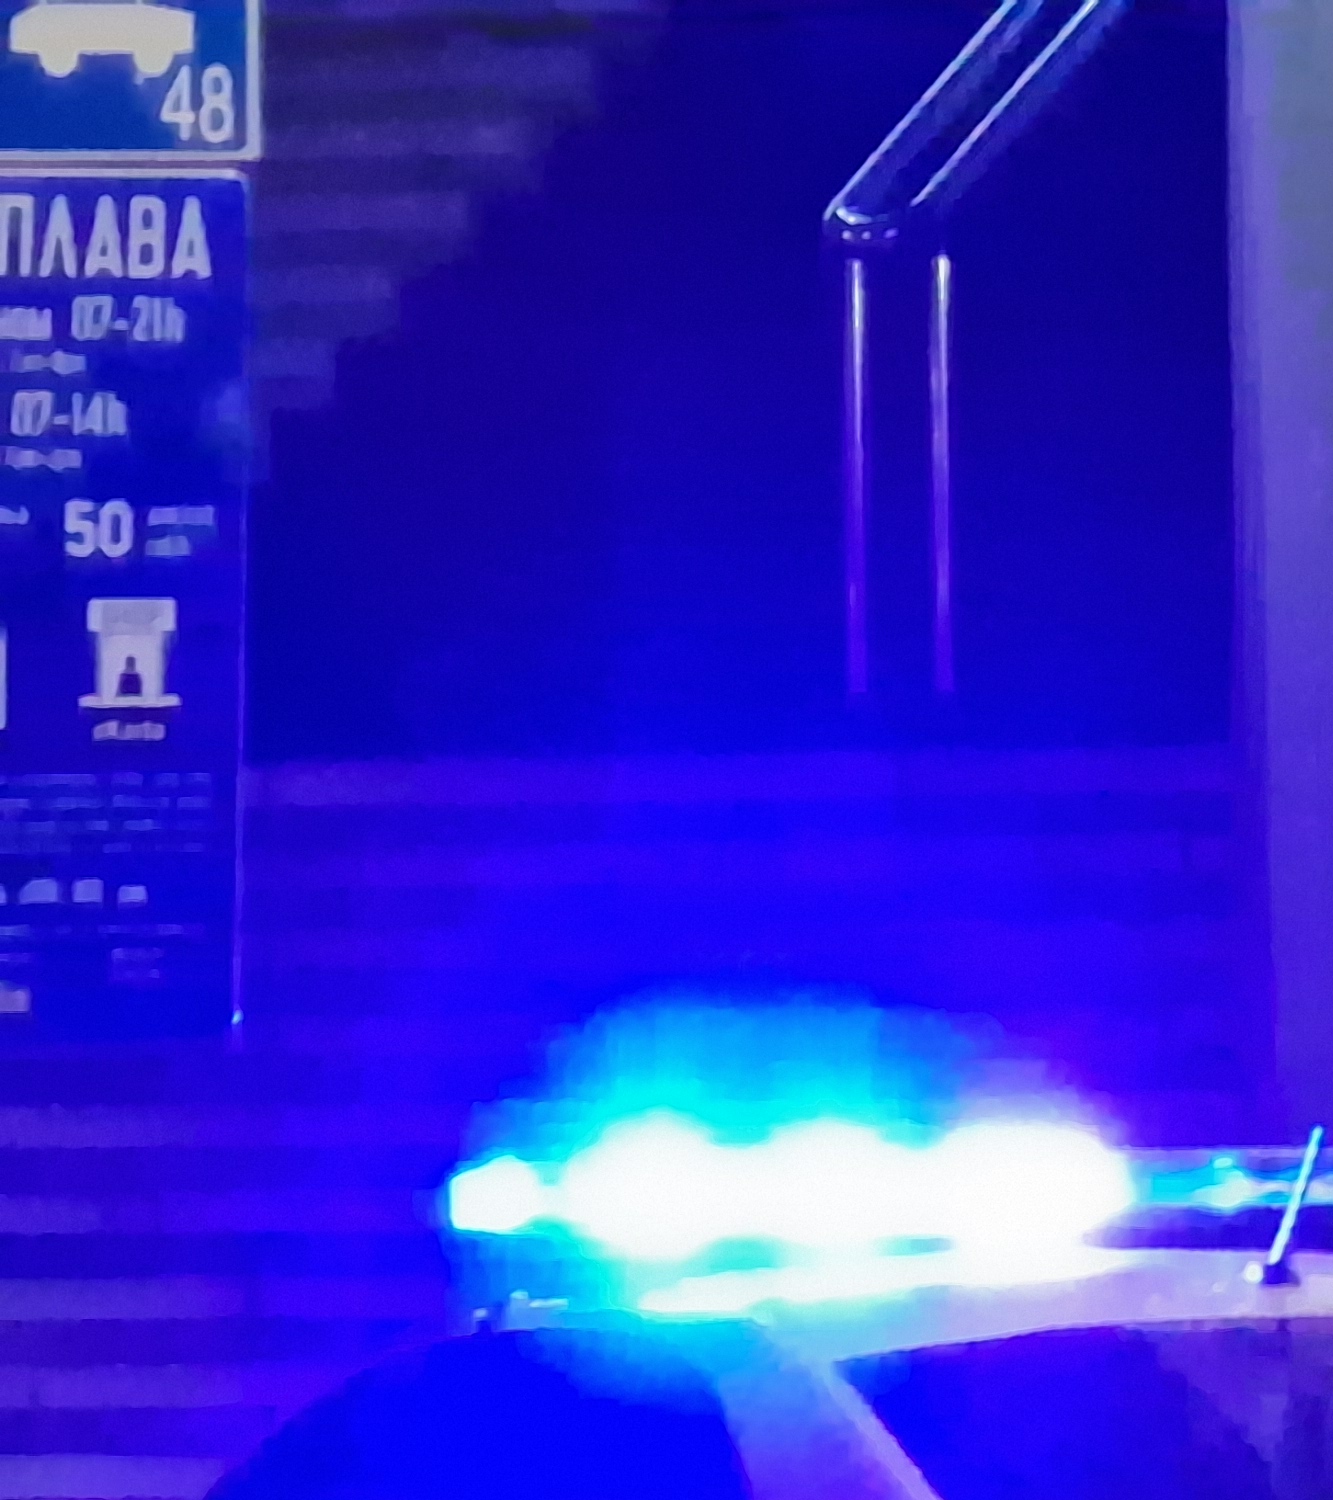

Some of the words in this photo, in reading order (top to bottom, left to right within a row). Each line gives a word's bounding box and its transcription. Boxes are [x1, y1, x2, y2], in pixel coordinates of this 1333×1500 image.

[160, 63, 236, 143] 48
[0, 194, 212, 279] ПЛАВА
[64, 498, 134, 558] 50
